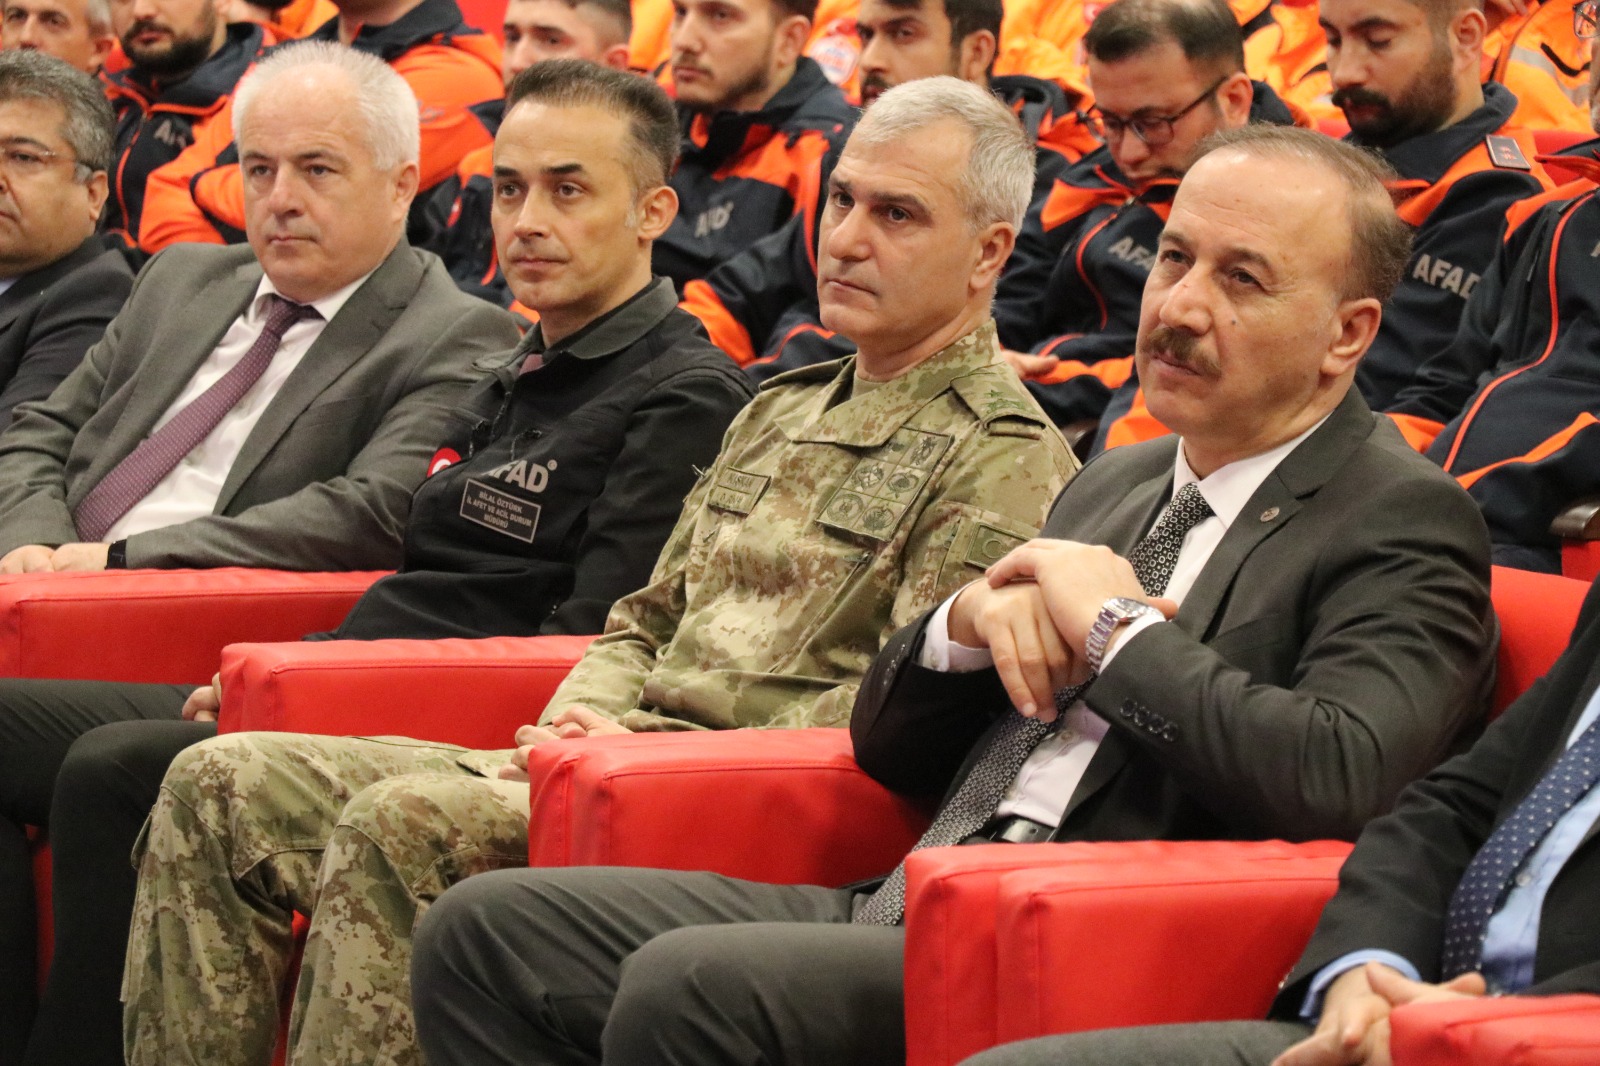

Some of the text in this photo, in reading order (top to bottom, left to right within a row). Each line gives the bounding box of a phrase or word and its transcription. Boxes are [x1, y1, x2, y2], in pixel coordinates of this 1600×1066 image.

[472, 499, 487, 510] AFET
[487, 504, 496, 514] VE
[509, 513, 532, 527] DURUM
[479, 491, 523, 514] BİLAL ÖZTÜRK
[483, 513, 509, 529] MÜDÜRÜ
